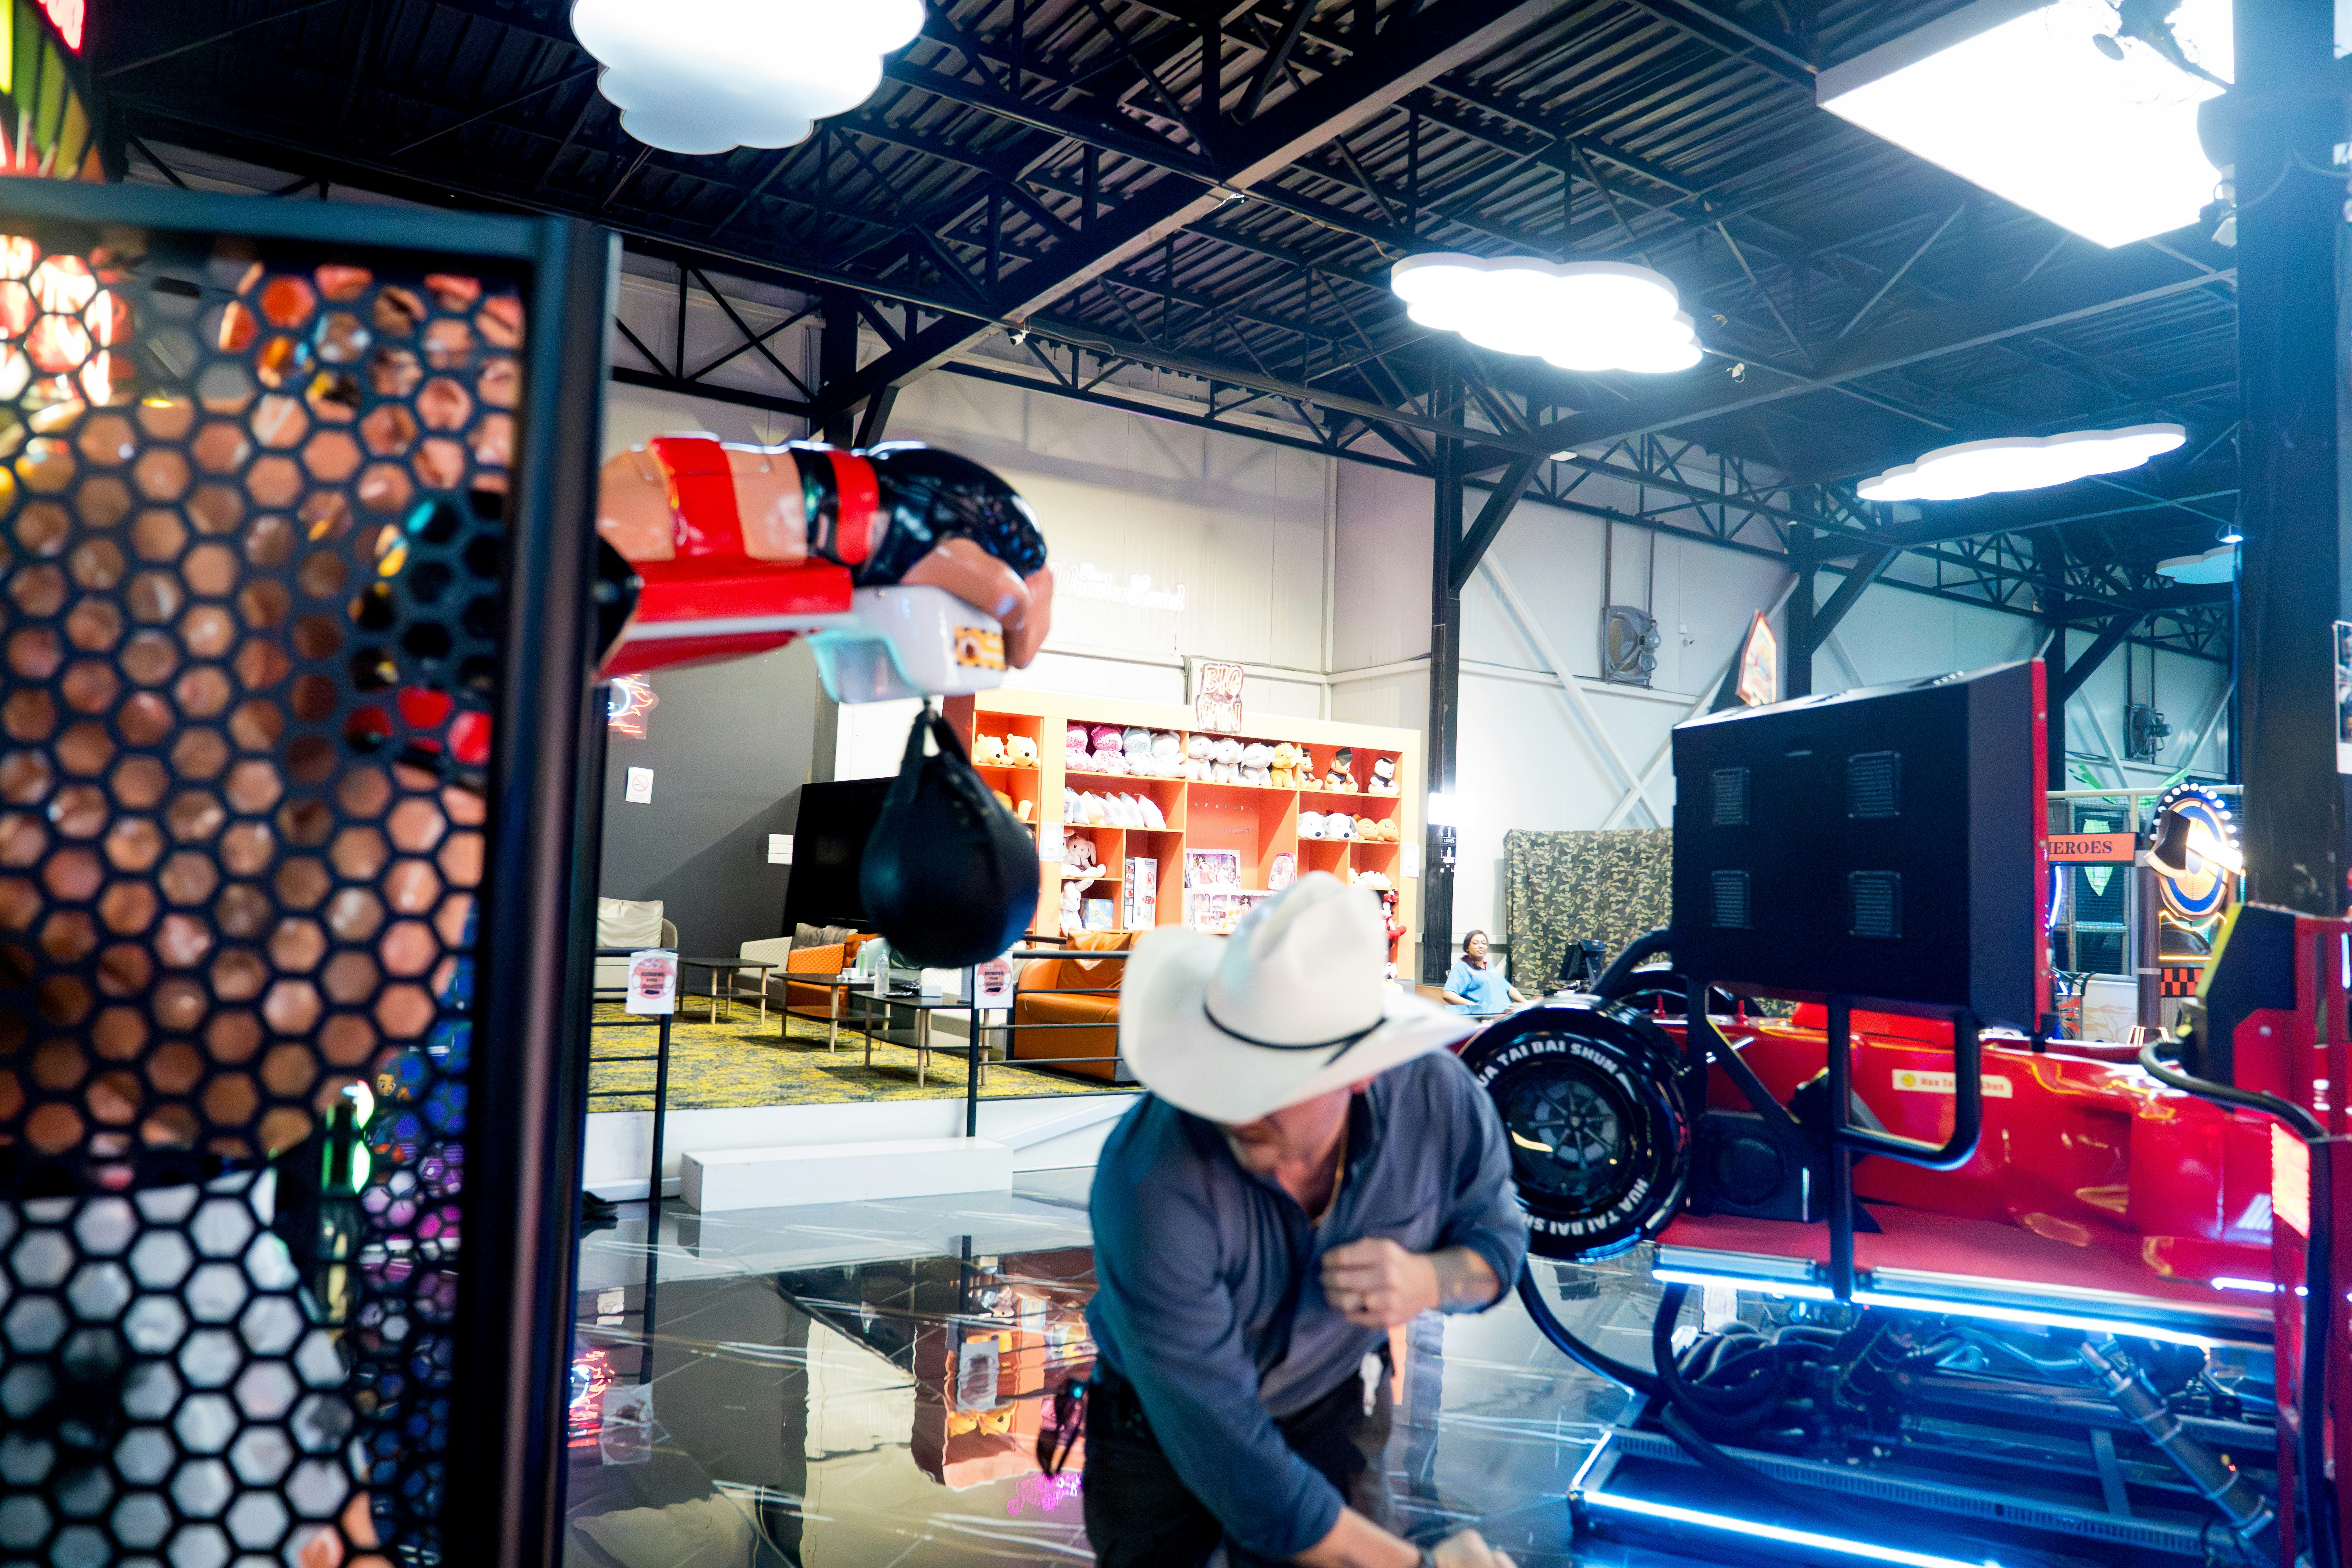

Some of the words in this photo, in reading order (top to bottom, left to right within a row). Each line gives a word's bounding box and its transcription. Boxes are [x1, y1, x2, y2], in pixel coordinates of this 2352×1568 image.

[1202, 665, 1243, 697] BIG
[1197, 695, 1242, 732] WIN
[1496, 1044, 1529, 1066] TAI
[1531, 1040, 1566, 1054] DAI
[1549, 1220, 1584, 1236] DAI
[1587, 1210, 1621, 1234] TAI
